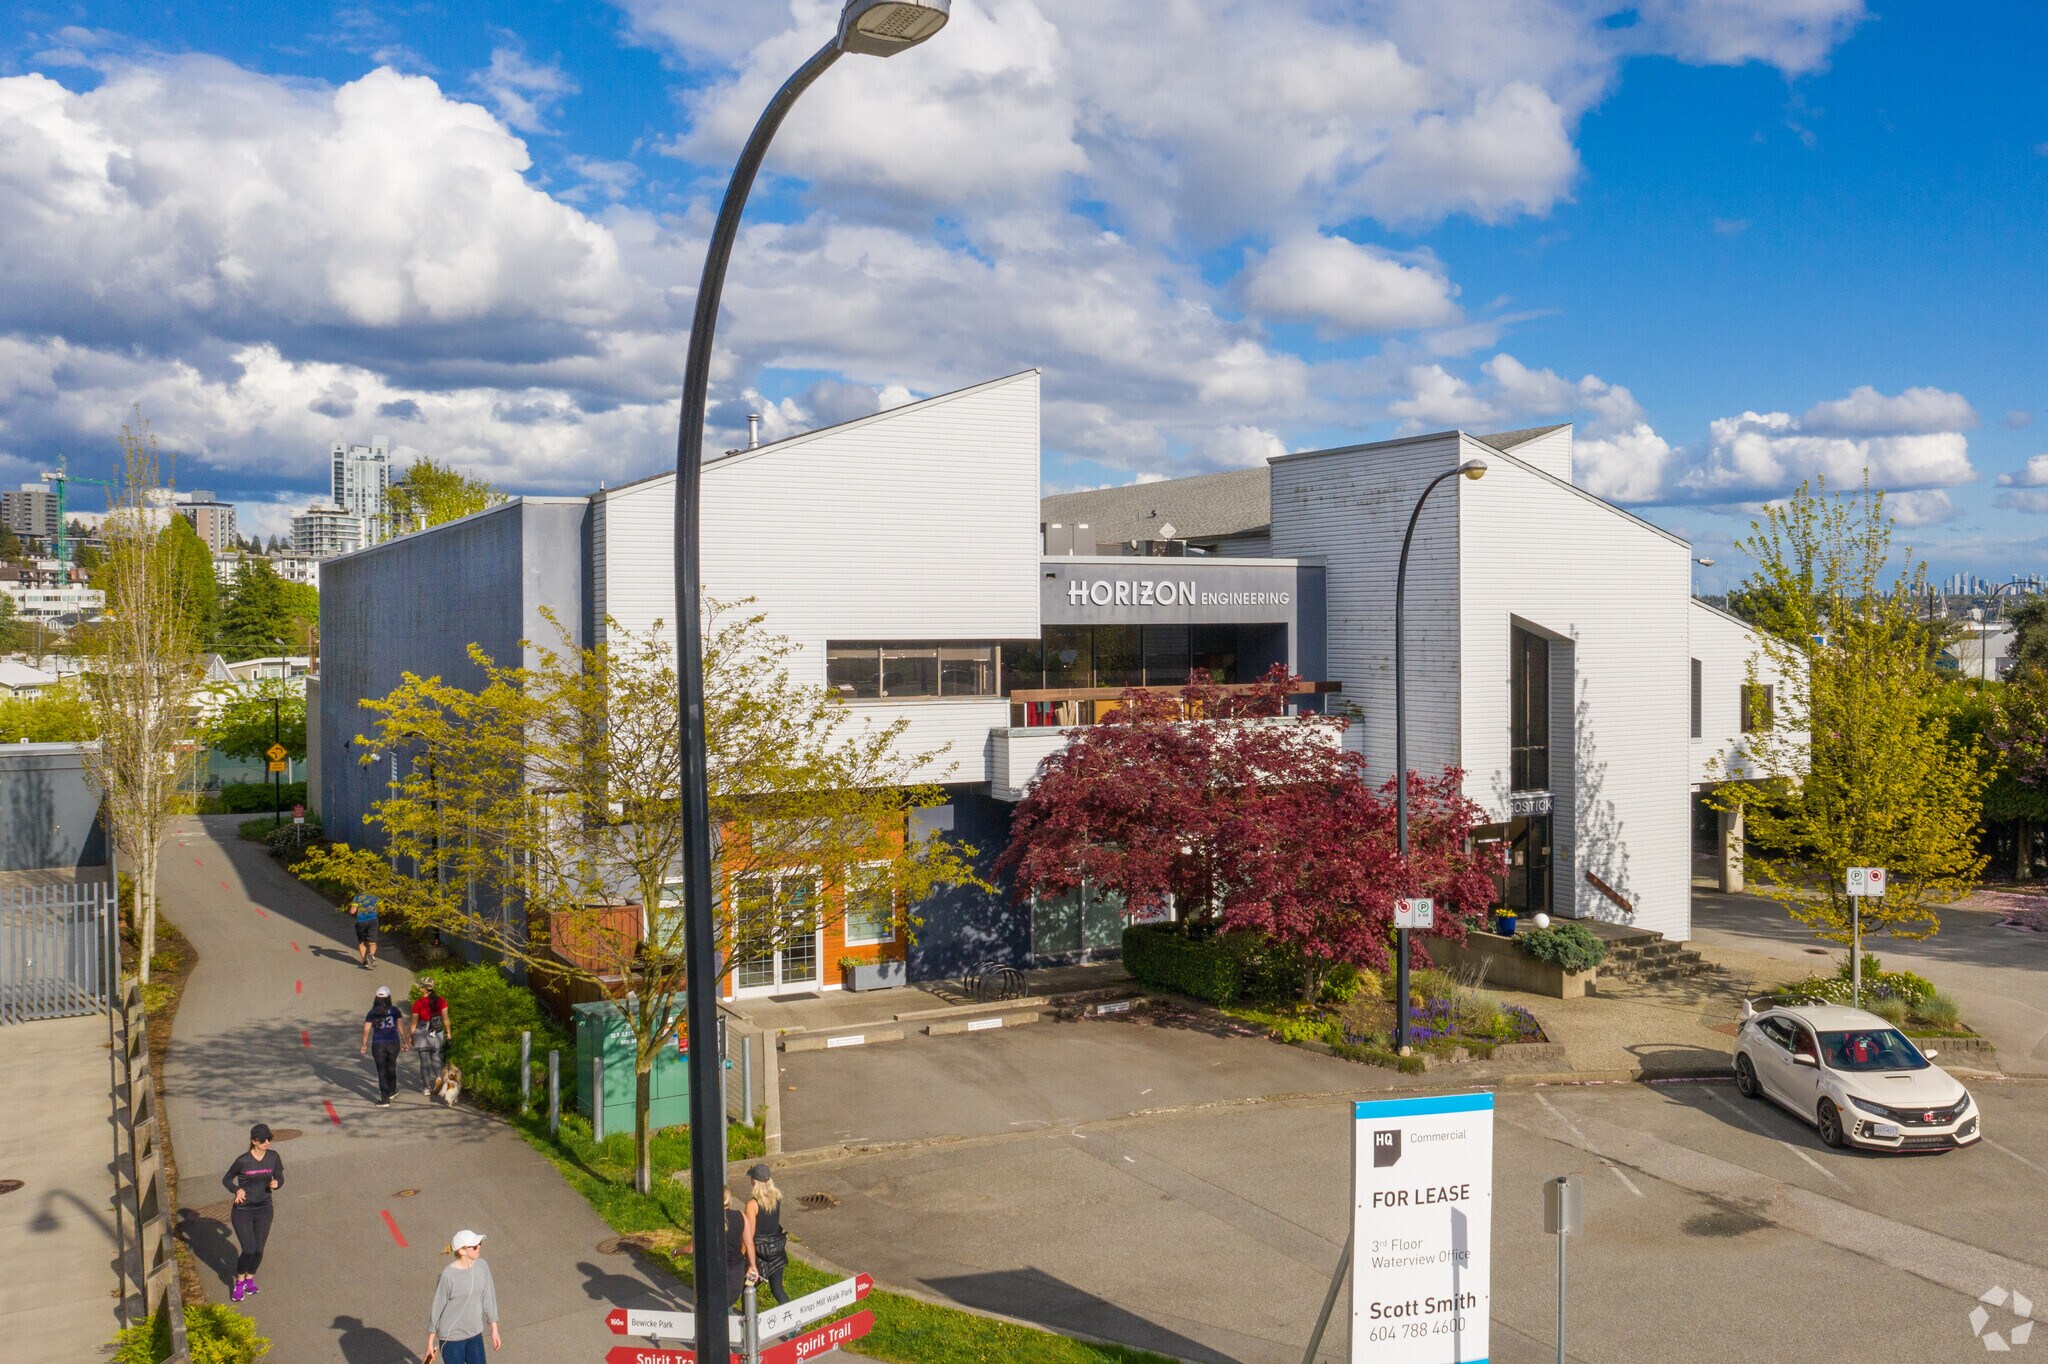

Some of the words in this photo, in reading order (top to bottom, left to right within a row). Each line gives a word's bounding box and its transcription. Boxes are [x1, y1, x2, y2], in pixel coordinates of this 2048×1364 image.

[1067, 580, 1196, 606] HORIZON
[1201, 592, 1290, 605] ENGINEERING
[1376, 1133, 1393, 1146] HQ
[1410, 1129, 1467, 1143] Commercial
[1373, 1190, 1409, 1208] FOR
[1415, 1184, 1470, 1205] LEASE
[1372, 1239, 1388, 1253] 3rd
[1391, 1238, 1424, 1251] Floor
[1371, 1253, 1436, 1269] Waterview
[1439, 1249, 1471, 1263] Office
[857, 1282, 870, 1292] 300m
[800, 1303, 816, 1314] Kings
[817, 1298, 826, 1308] Mill
[827, 1293, 840, 1303] Walk
[841, 1288, 853, 1298] Park
[1370, 1300, 1419, 1320] Scott
[1424, 1292, 1476, 1314] Smith
[610, 1318, 624, 1326] 160m
[631, 1318, 658, 1328] Bewicke
[659, 1320, 673, 1329] Park
[1369, 1324, 1397, 1342] 604
[1402, 1321, 1428, 1338] 788
[1432, 1317, 1466, 1334] 4600
[796, 1333, 825, 1356] Spirit
[829, 1322, 851, 1343] Trail
